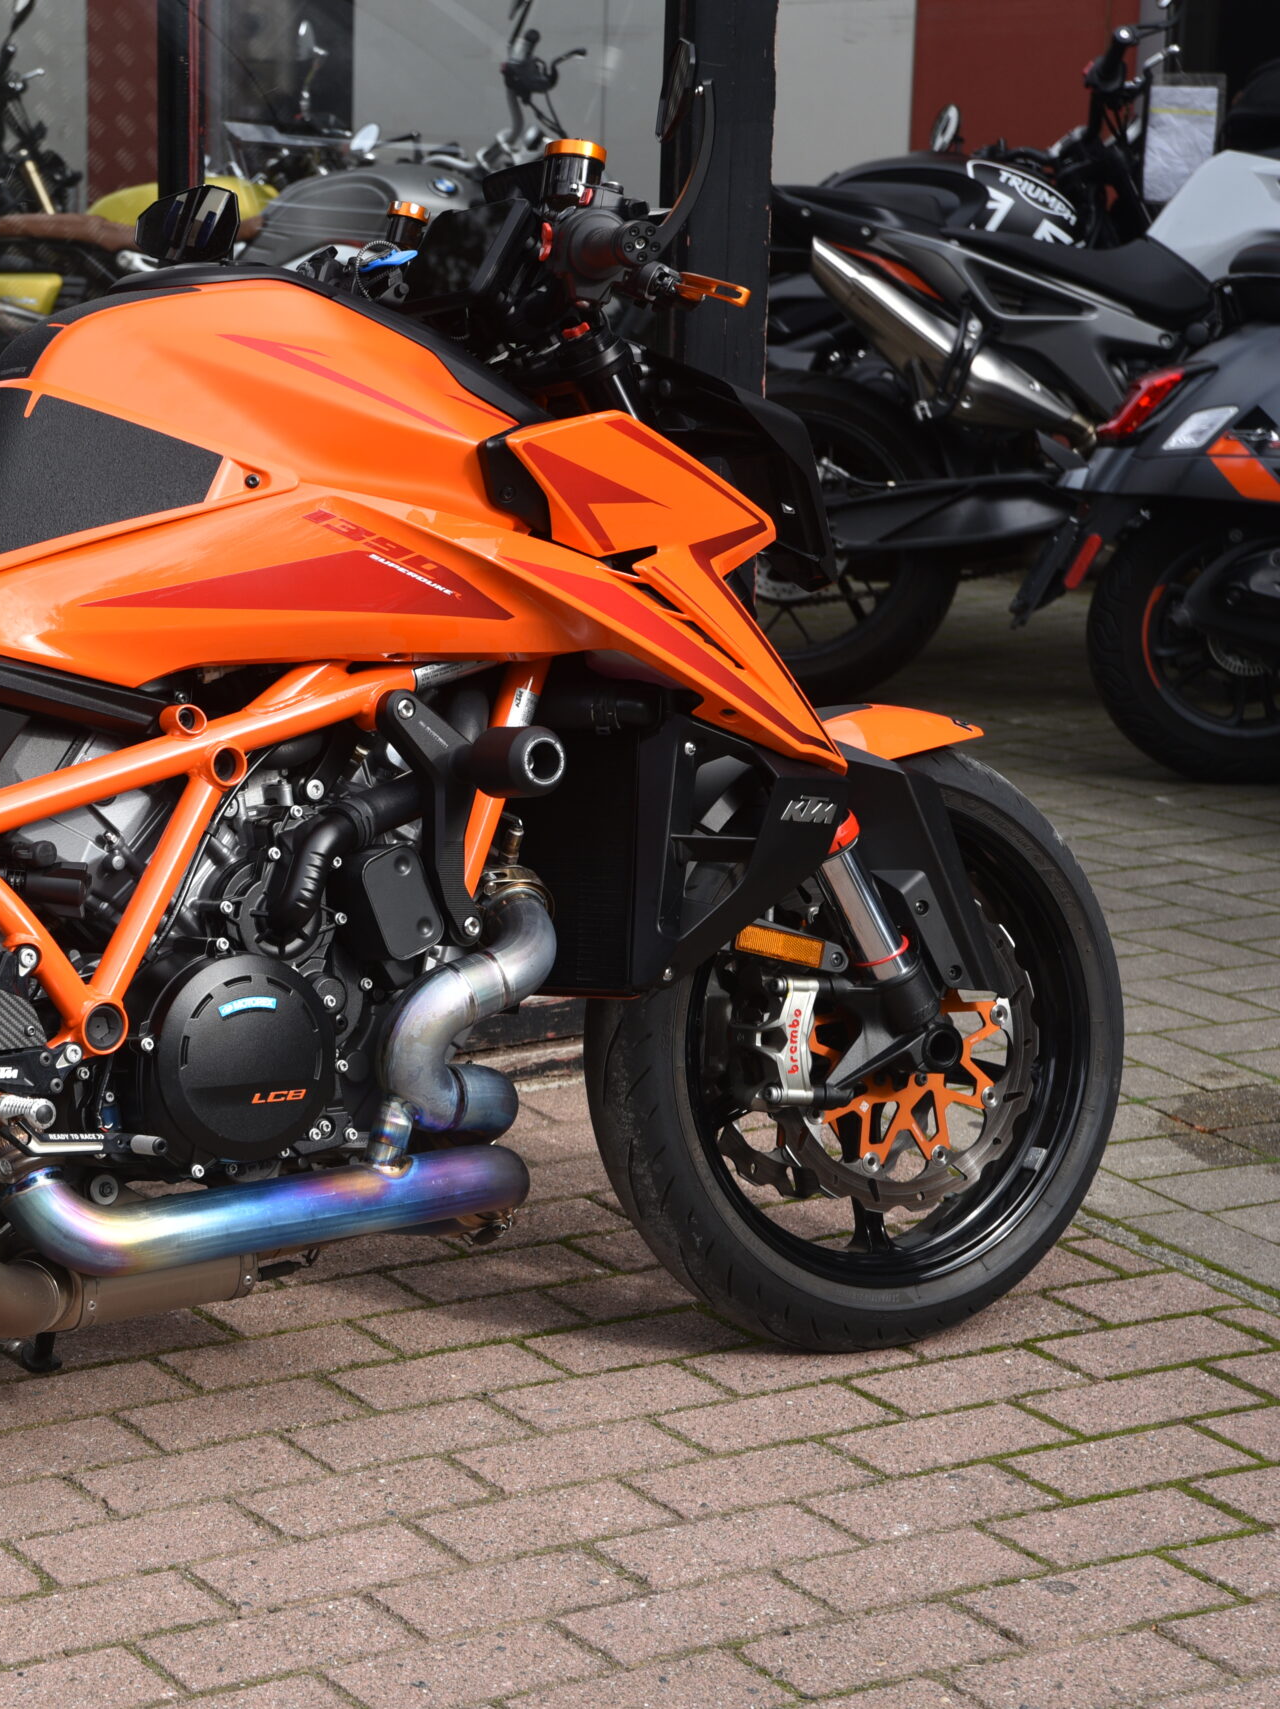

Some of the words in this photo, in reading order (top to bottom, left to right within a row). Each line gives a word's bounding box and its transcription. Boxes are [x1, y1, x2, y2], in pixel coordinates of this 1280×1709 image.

[999, 170, 1078, 226] TRIUMPH
[301, 508, 440, 580] 1390
[780, 795, 838, 824] KTM
[787, 1008, 803, 1075] brembo
[251, 1088, 307, 1105] LC8
